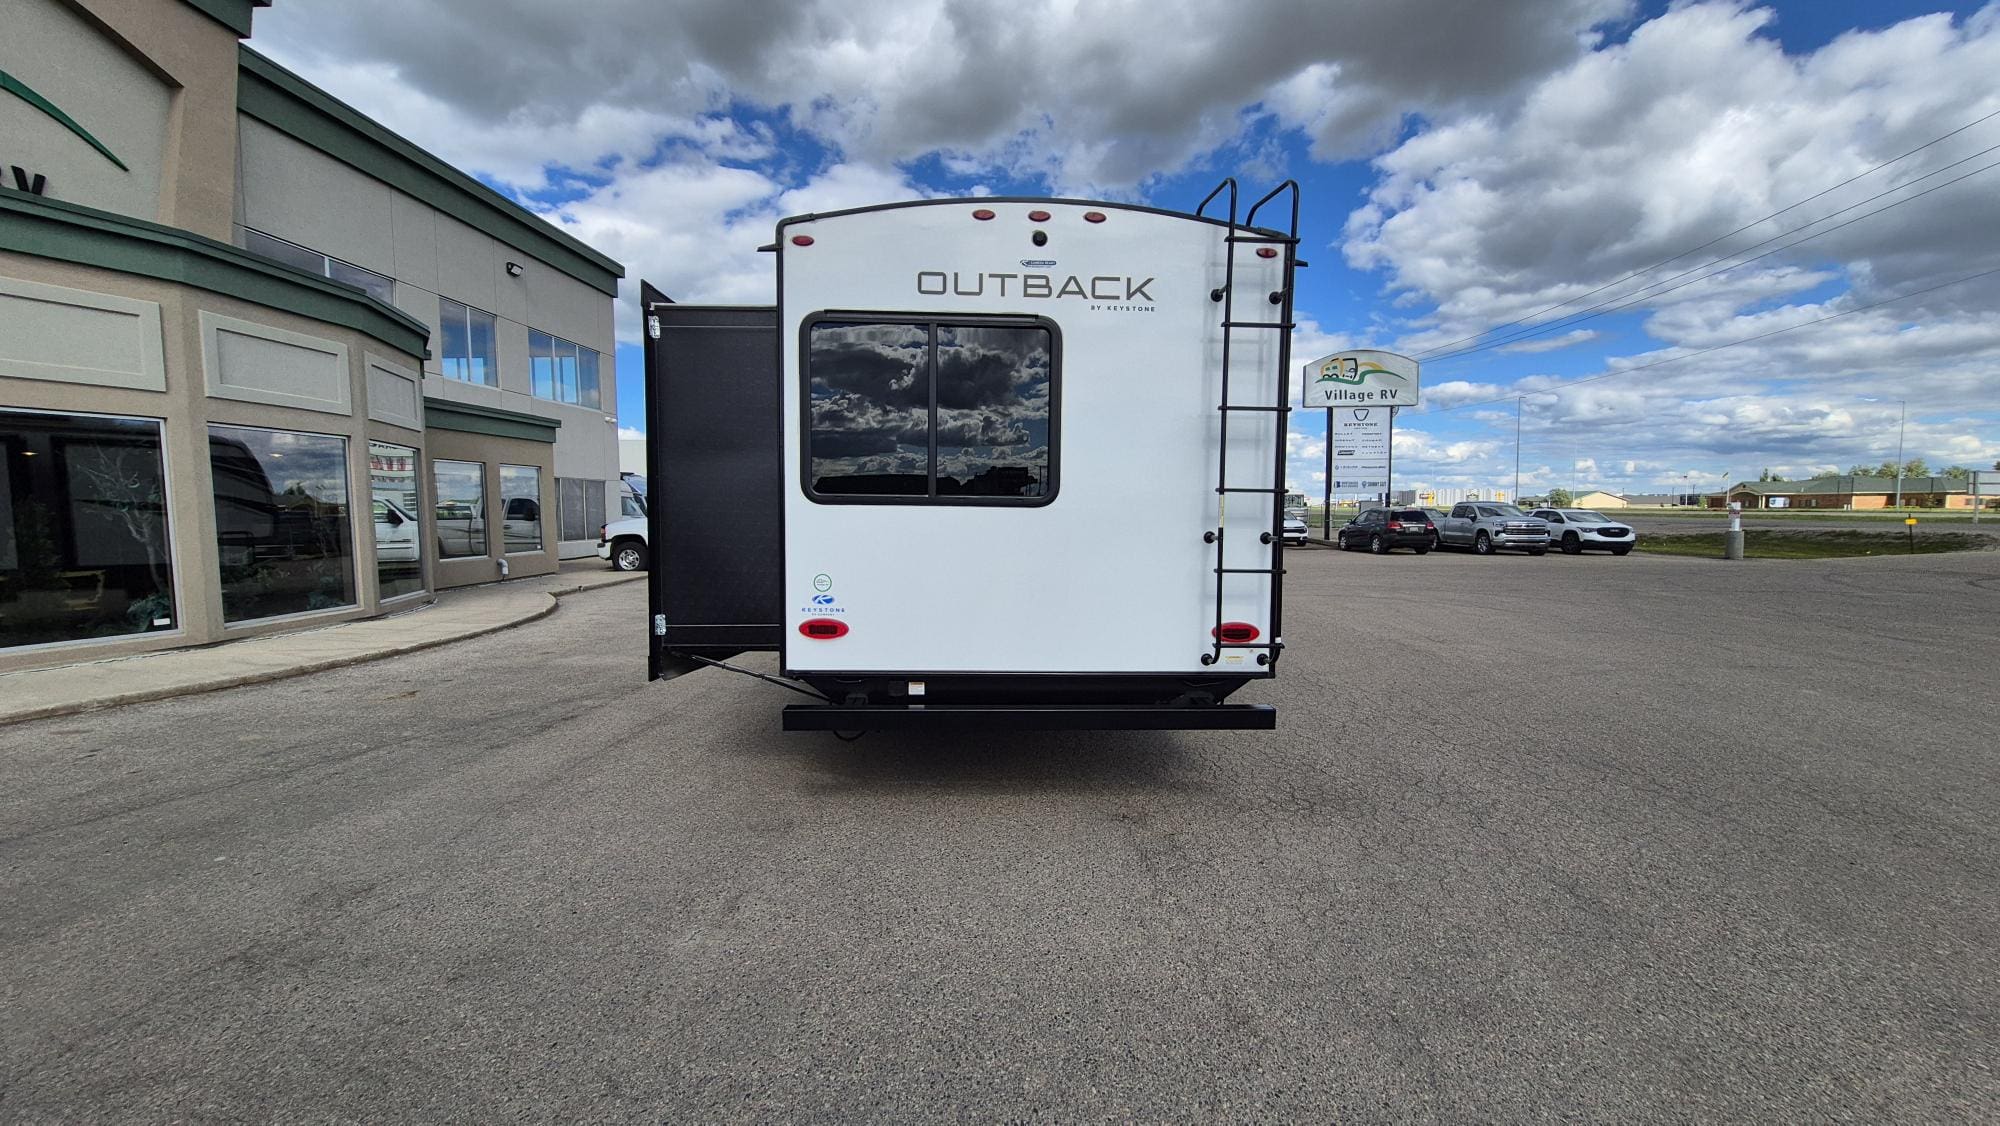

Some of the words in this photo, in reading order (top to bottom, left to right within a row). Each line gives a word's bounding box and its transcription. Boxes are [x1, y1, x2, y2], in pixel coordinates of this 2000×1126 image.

[0, 165, 46, 196] V
[917, 271, 1155, 301] OUTBACK
[1325, 389, 1374, 402] Village
[1380, 389, 1398, 399] RV
